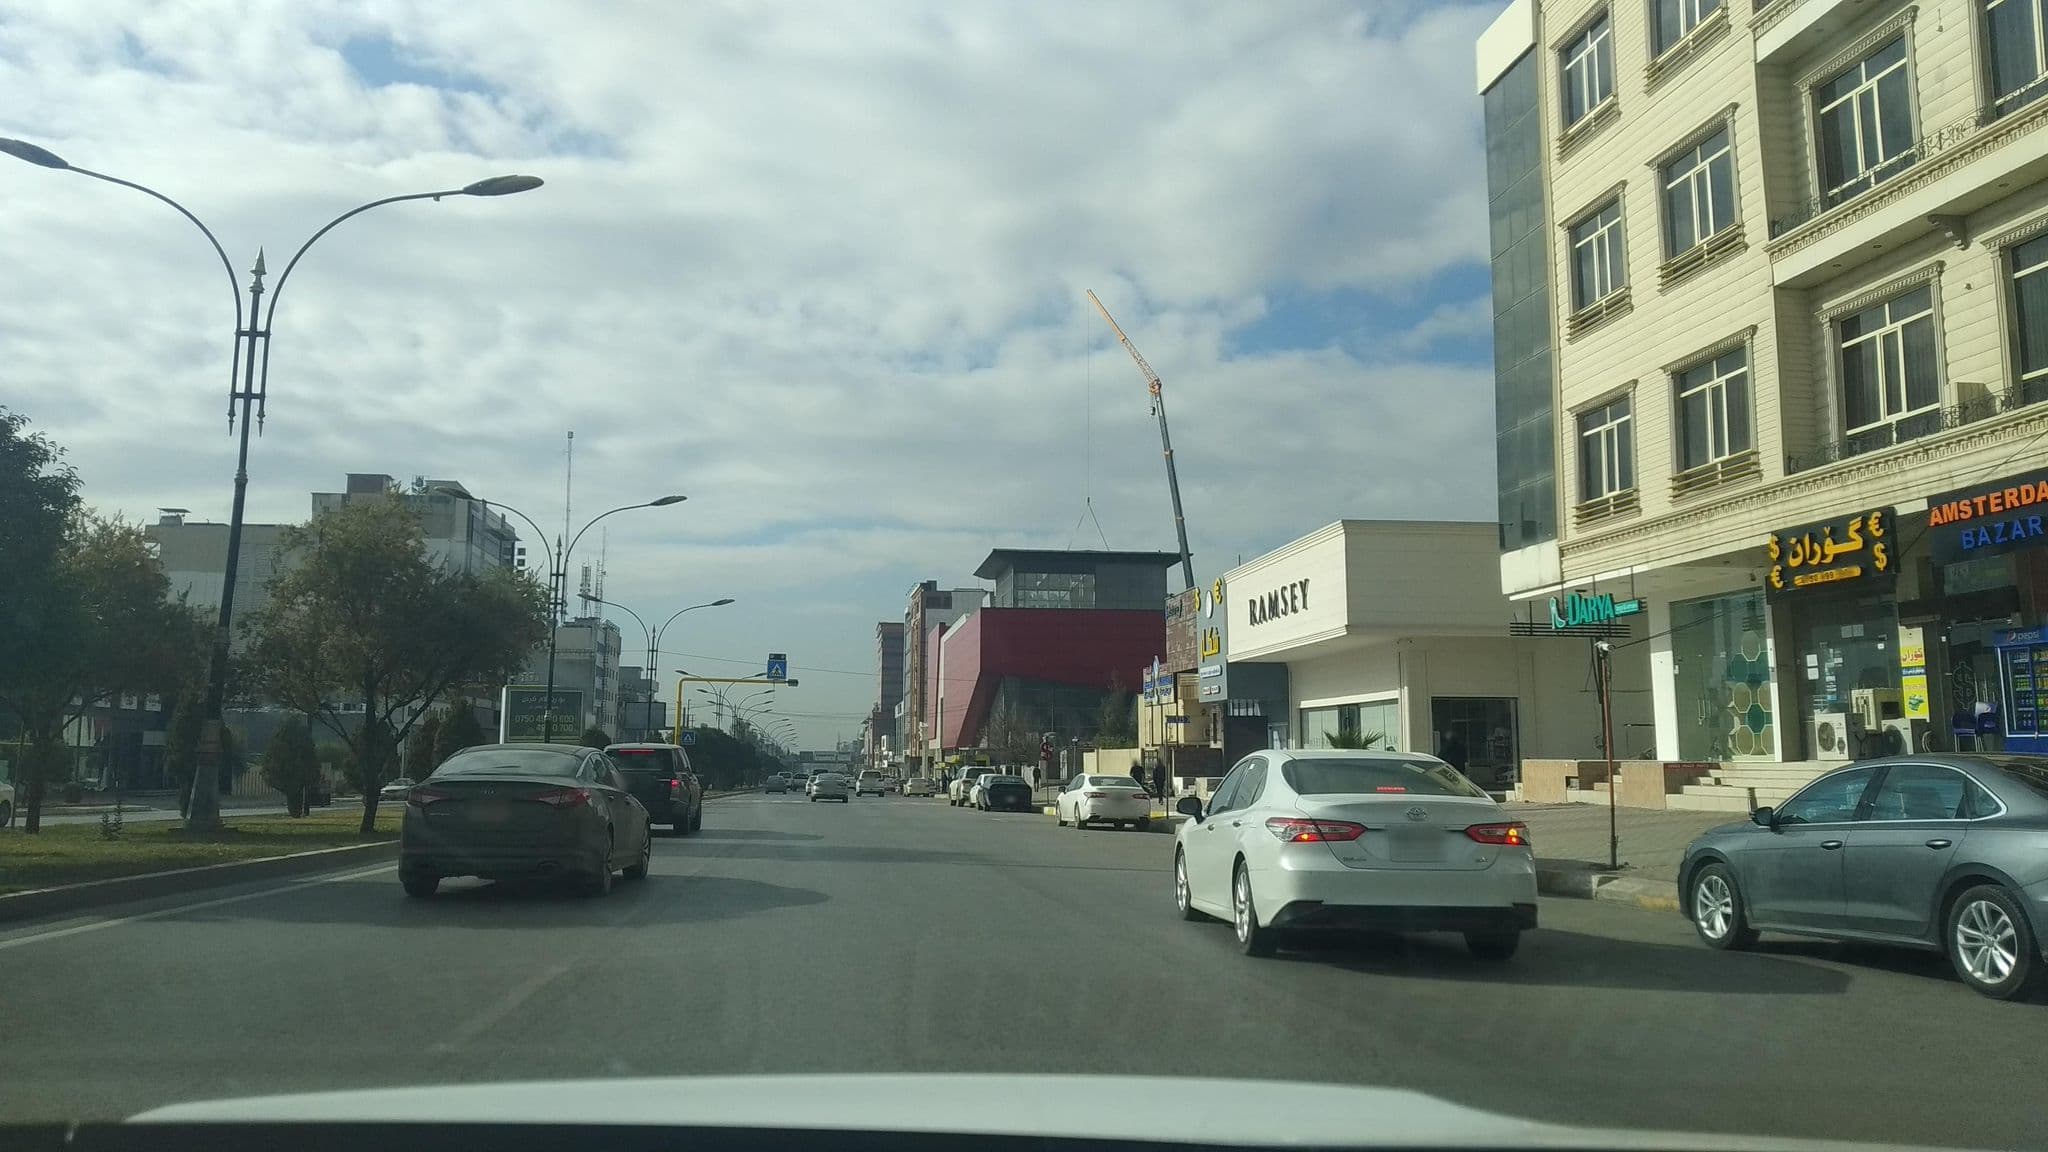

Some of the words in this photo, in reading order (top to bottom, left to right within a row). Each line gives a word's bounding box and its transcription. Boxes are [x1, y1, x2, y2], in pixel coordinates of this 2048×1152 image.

[1928, 481, 2048, 527] AMSTERDA
[1961, 515, 2044, 550] BAZAR
[1873, 542, 1888, 571] $
[1248, 578, 1310, 627] RAMSEY
